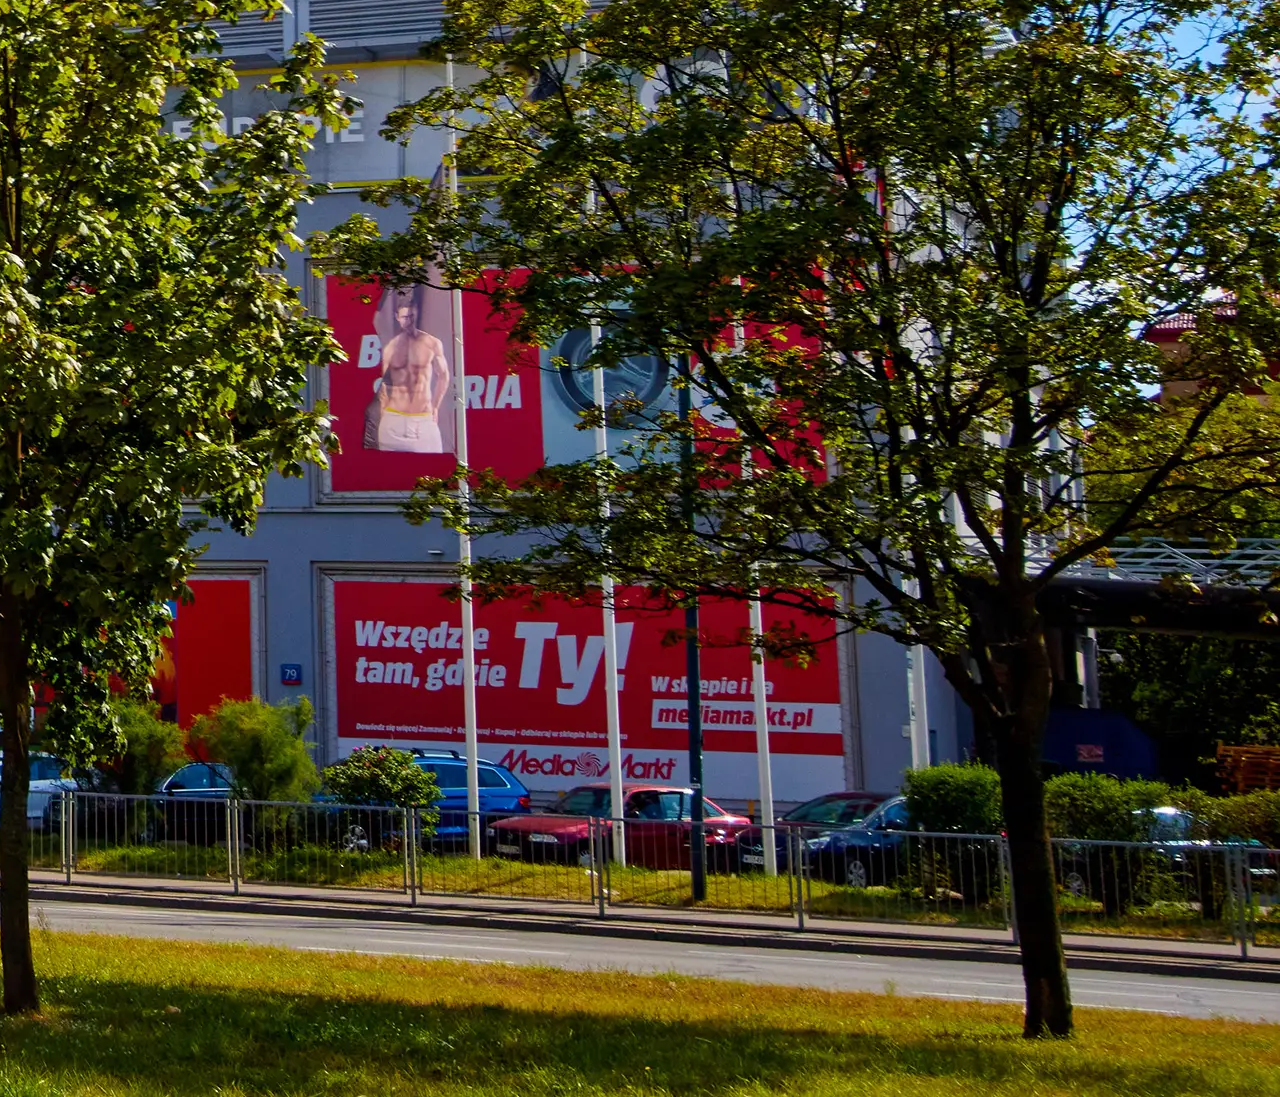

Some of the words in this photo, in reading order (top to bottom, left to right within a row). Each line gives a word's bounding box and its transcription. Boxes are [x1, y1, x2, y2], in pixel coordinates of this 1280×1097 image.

[355, 620, 489, 654] Wszędze
[284, 668, 297, 680] 79
[355, 656, 420, 688] tam,
[425, 658, 507, 692] gdie
[651, 675, 670, 692] W
[497, 748, 577, 778] Media
